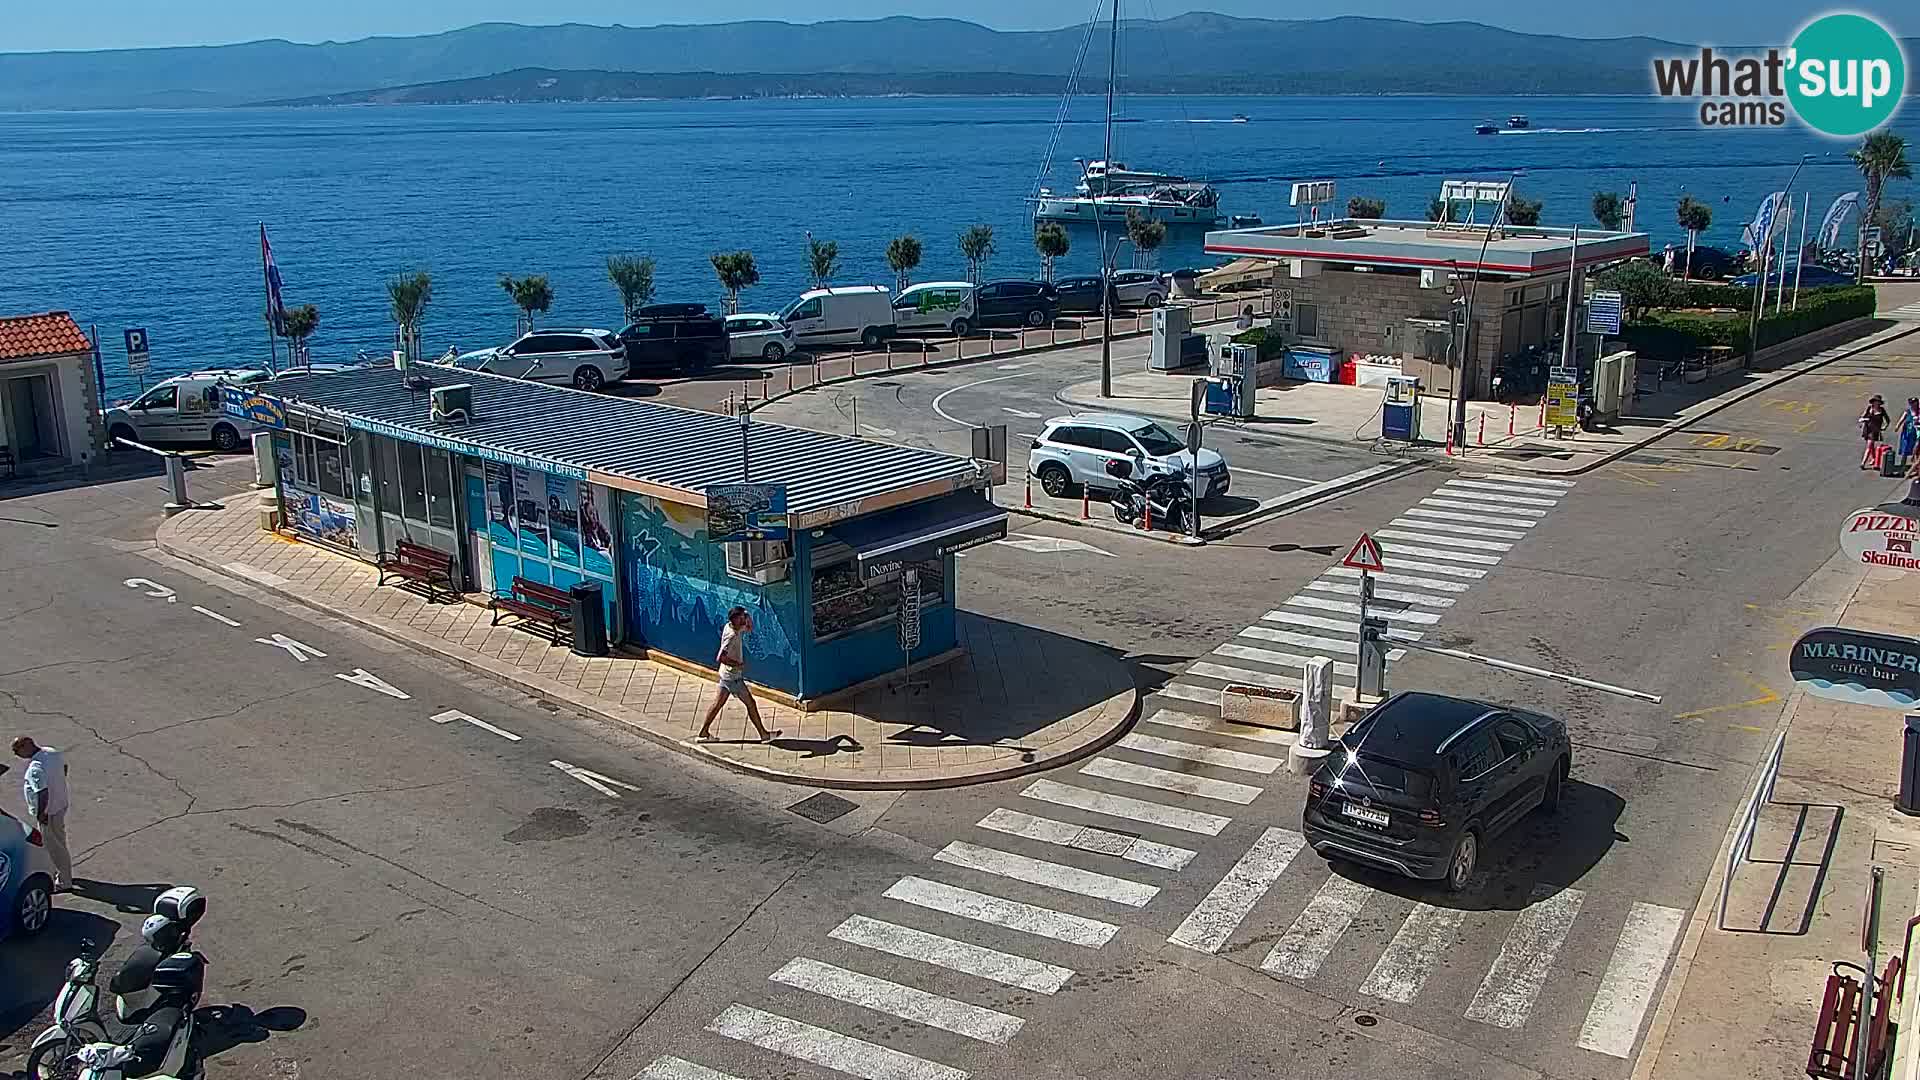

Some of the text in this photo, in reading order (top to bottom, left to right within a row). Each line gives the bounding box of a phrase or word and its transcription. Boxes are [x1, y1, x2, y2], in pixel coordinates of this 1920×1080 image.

[437, 438, 468, 452] POSTAJA
[479, 446, 493, 459] BUS
[494, 451, 526, 466] STATION
[529, 459, 554, 473] TICKET
[556, 465, 583, 478] OFFICE
[1883, 531, 1919, 542] GRILL
[1802, 642, 1920, 673] MARINER
[1831, 663, 1899, 681] caffe bar
